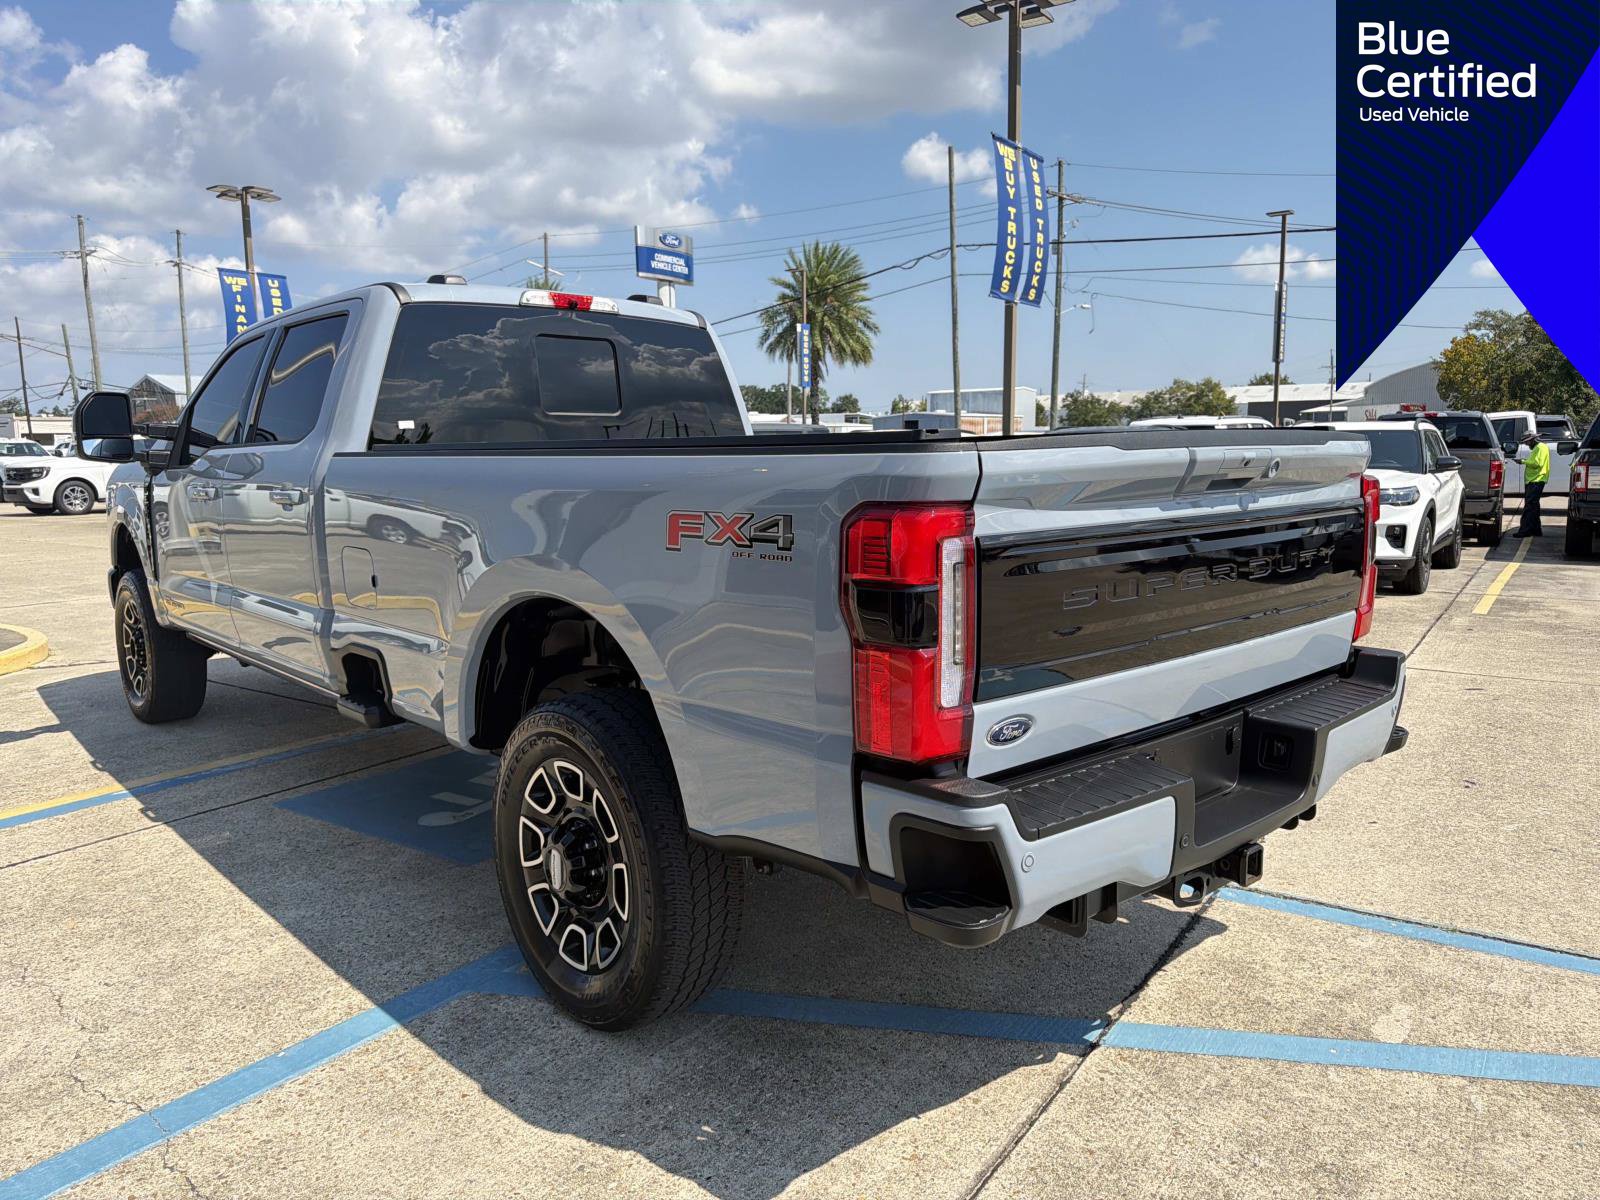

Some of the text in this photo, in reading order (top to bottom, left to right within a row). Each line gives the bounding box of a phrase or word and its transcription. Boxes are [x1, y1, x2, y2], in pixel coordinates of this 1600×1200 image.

[996, 141, 1017, 293] WE BUY TRUCKS
[1028, 157, 1045, 301] USED TRUCKS
[650, 260, 689, 275] VEHICLE CENTER
[654, 253, 686, 267] COMMERCIAL
[223, 275, 248, 286] WE
[267, 279, 284, 315] USED
[665, 509, 794, 552] FX4
[731, 551, 792, 562] OFF ROAD
[1063, 545, 1336, 610] SUPER DUTY
